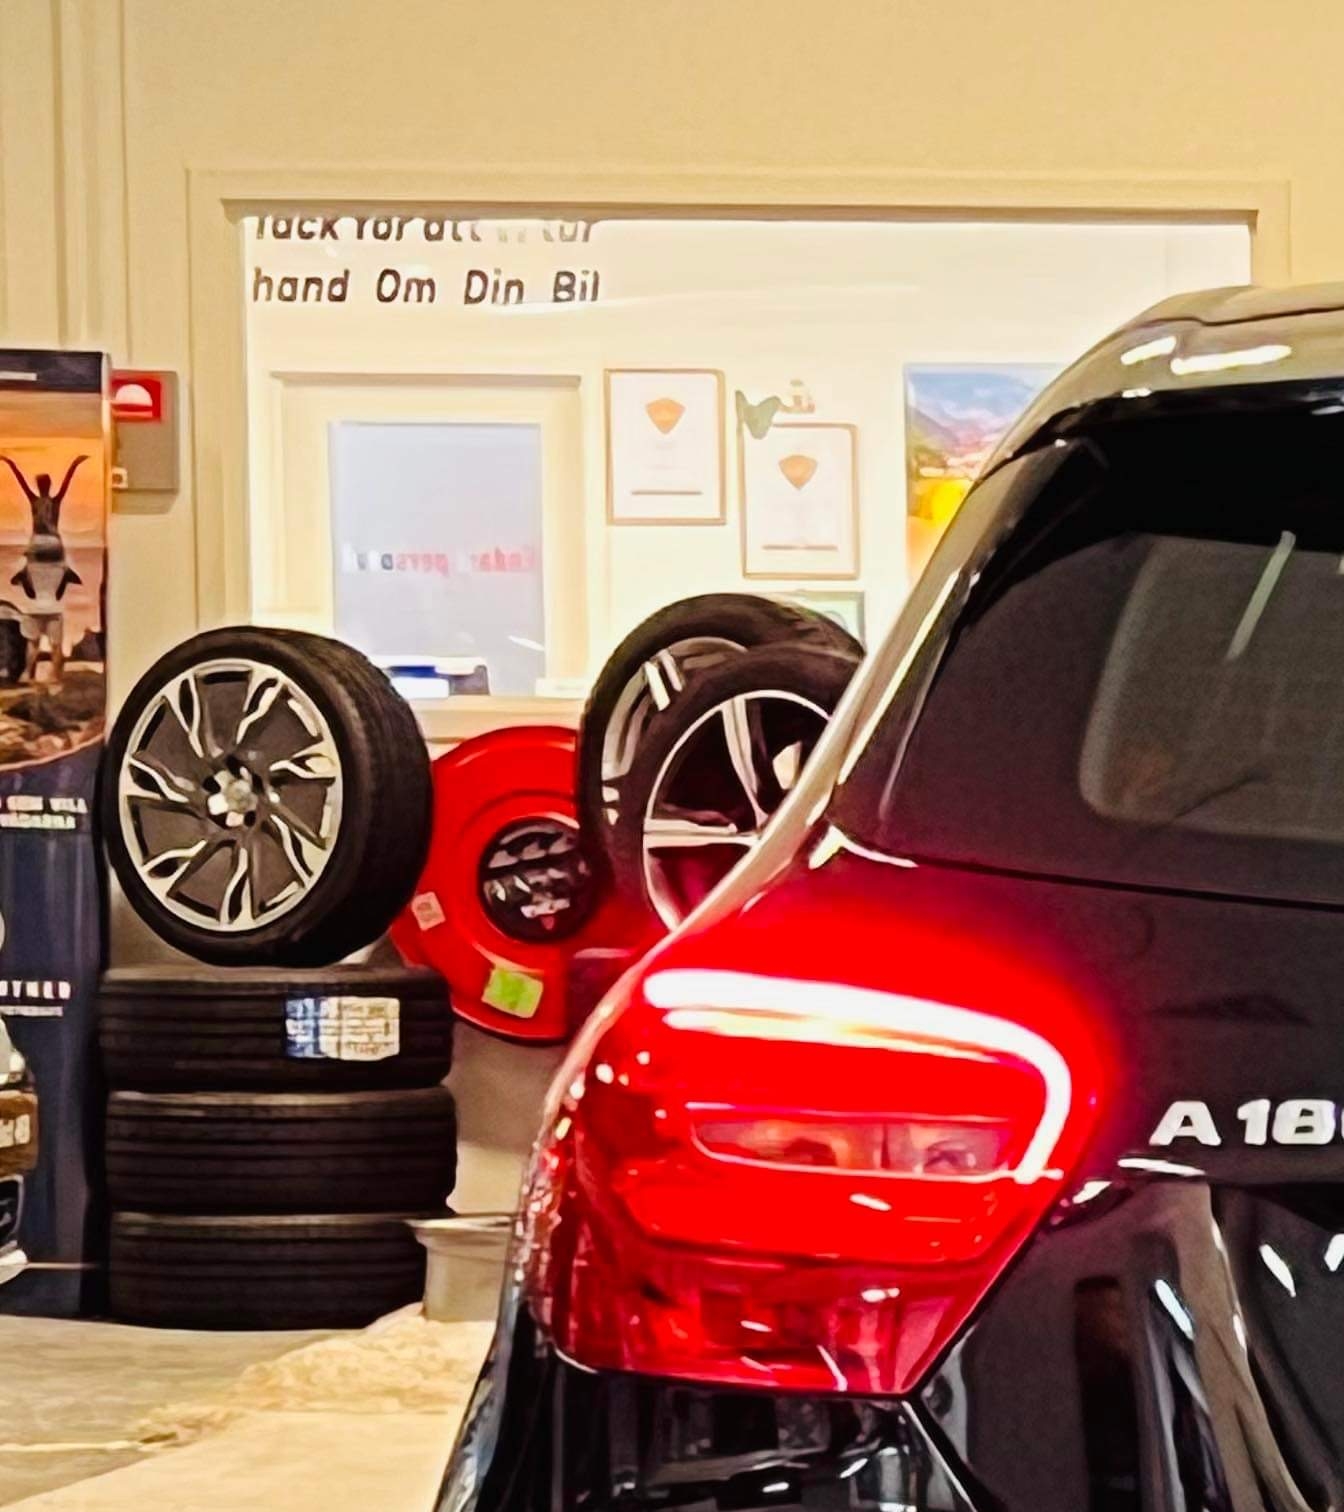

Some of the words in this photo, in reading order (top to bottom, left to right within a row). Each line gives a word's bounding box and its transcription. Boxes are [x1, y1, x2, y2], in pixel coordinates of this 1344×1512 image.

[253, 267, 350, 303] hand
[376, 268, 436, 303] Om
[463, 268, 525, 305] Din
[553, 269, 600, 304] Bil
[1148, 1100, 1222, 1146] A
